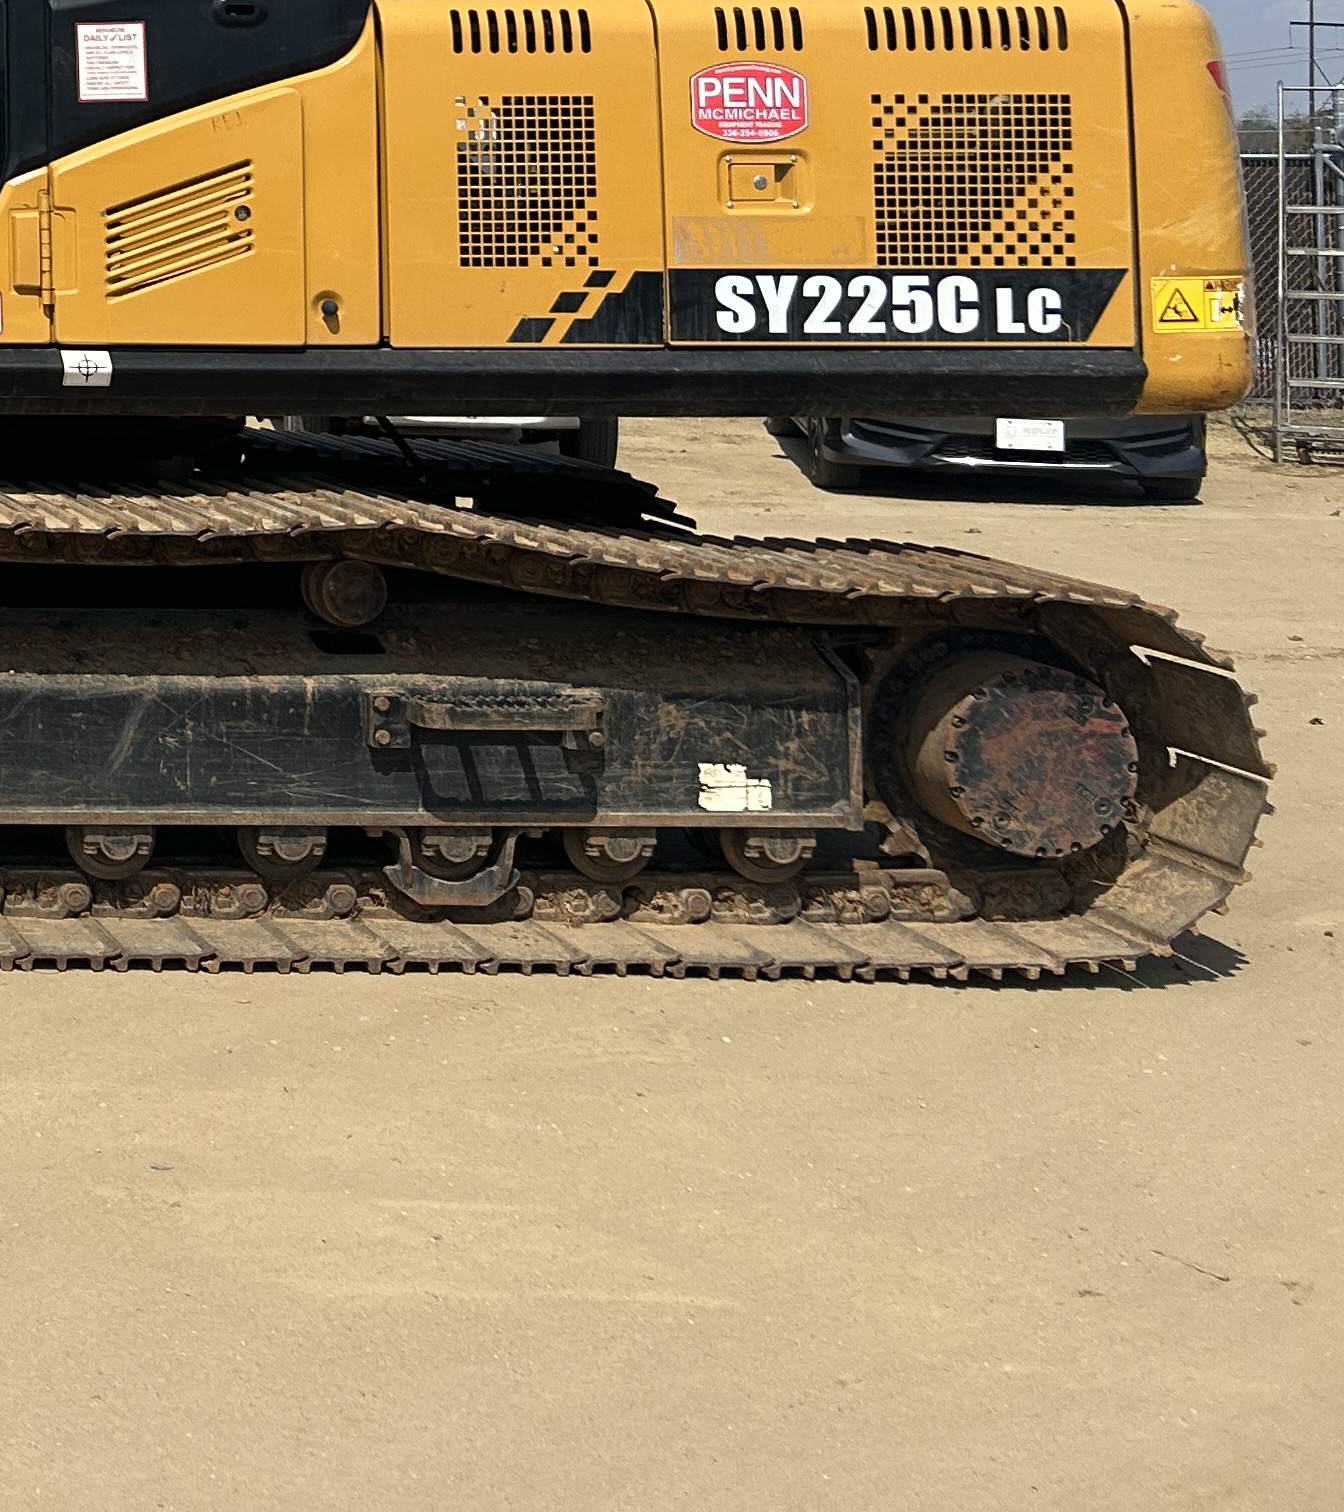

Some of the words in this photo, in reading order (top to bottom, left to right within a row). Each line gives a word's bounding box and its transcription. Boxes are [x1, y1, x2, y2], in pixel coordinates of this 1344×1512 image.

[83, 34, 109, 42] DAILY
[118, 33, 137, 41] LIST
[698, 77, 800, 108] PENN
[698, 108, 802, 120] MCMICHAEL
[714, 274, 980, 334] SY225C
[995, 287, 1062, 334] LC
